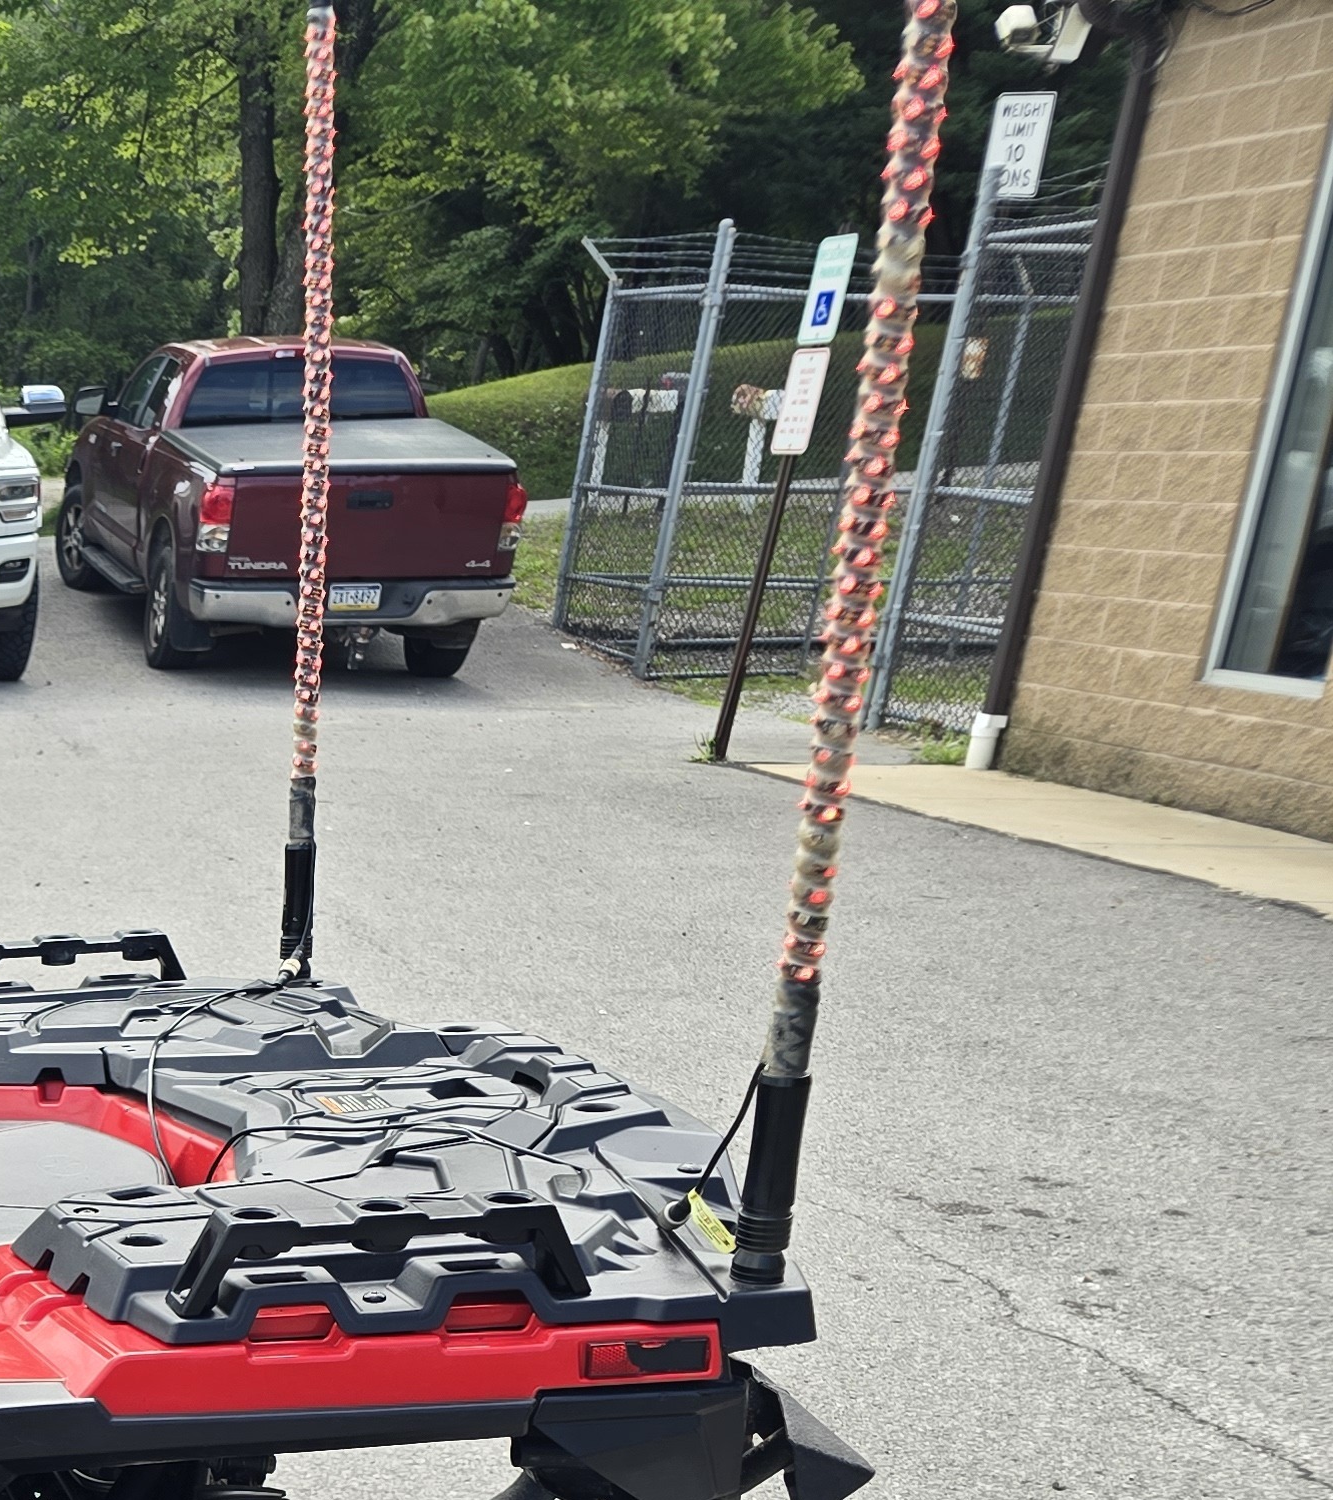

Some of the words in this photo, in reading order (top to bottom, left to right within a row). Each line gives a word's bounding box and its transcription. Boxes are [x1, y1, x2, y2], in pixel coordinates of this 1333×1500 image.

[1002, 102, 1049, 118] WEIGHT
[1004, 122, 1038, 137] LIMIT
[1005, 143, 1025, 162] 10
[997, 168, 1032, 188] ONS
[227, 561, 289, 571] TUNDRA
